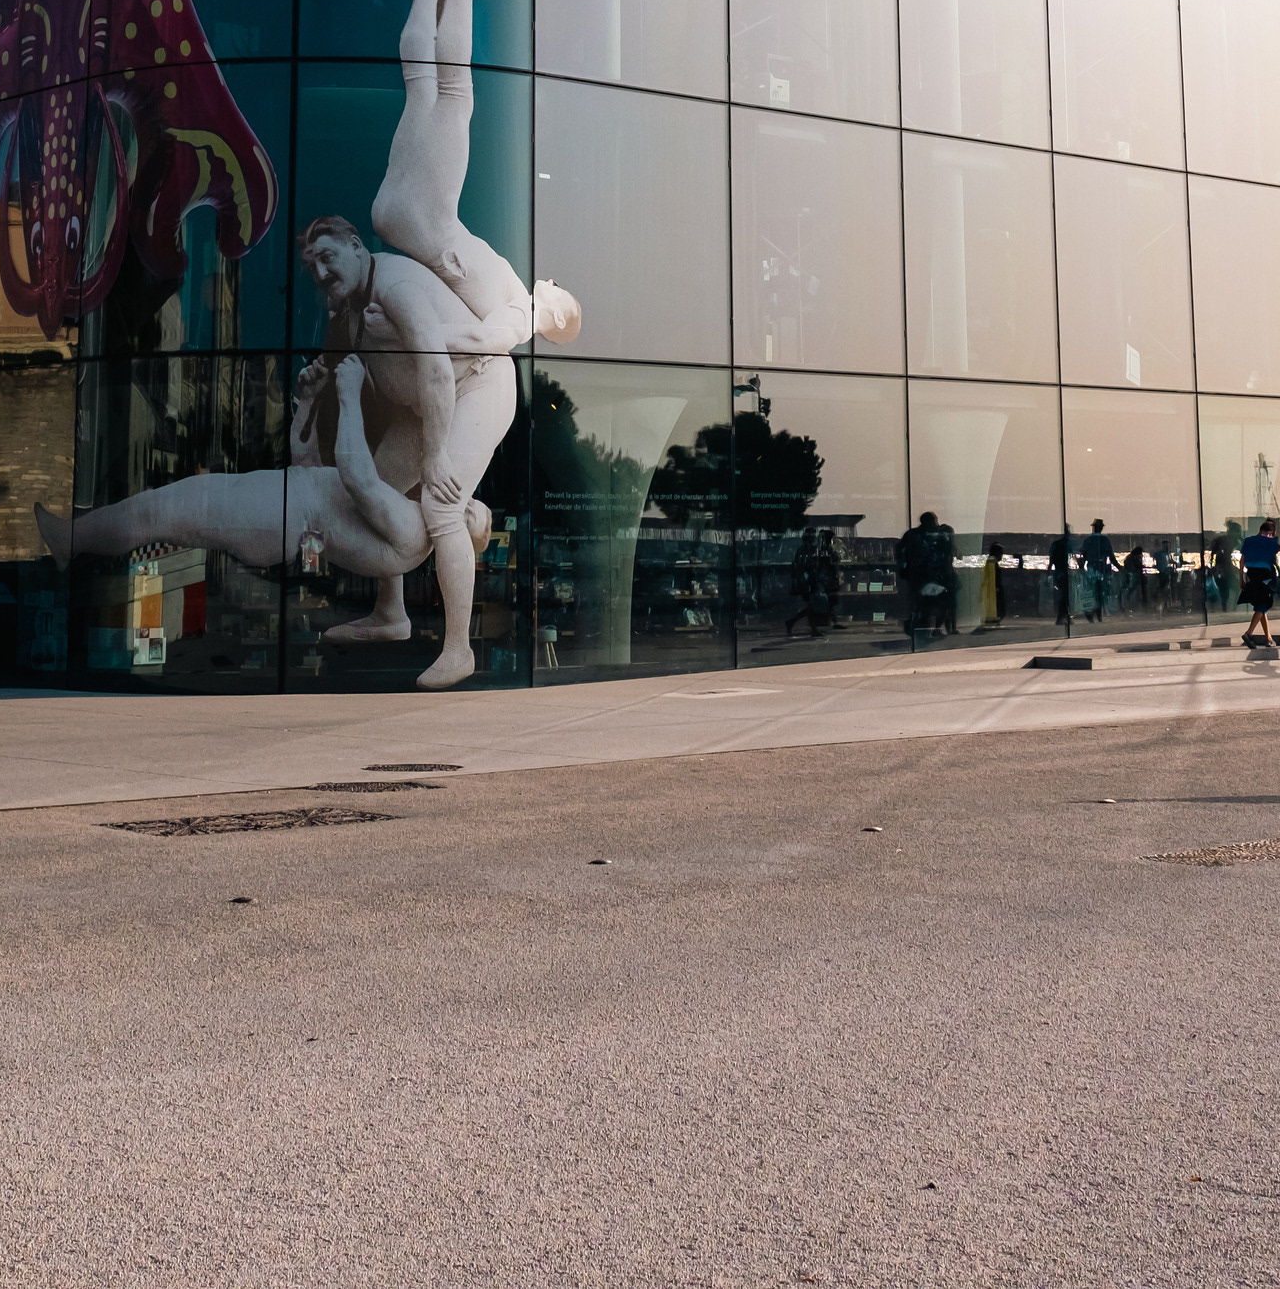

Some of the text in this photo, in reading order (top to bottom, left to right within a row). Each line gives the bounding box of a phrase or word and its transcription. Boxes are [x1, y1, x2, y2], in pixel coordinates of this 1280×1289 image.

[545, 491, 565, 499] Devant
[566, 491, 571, 499] la
[751, 491, 772, 500] Everyone
